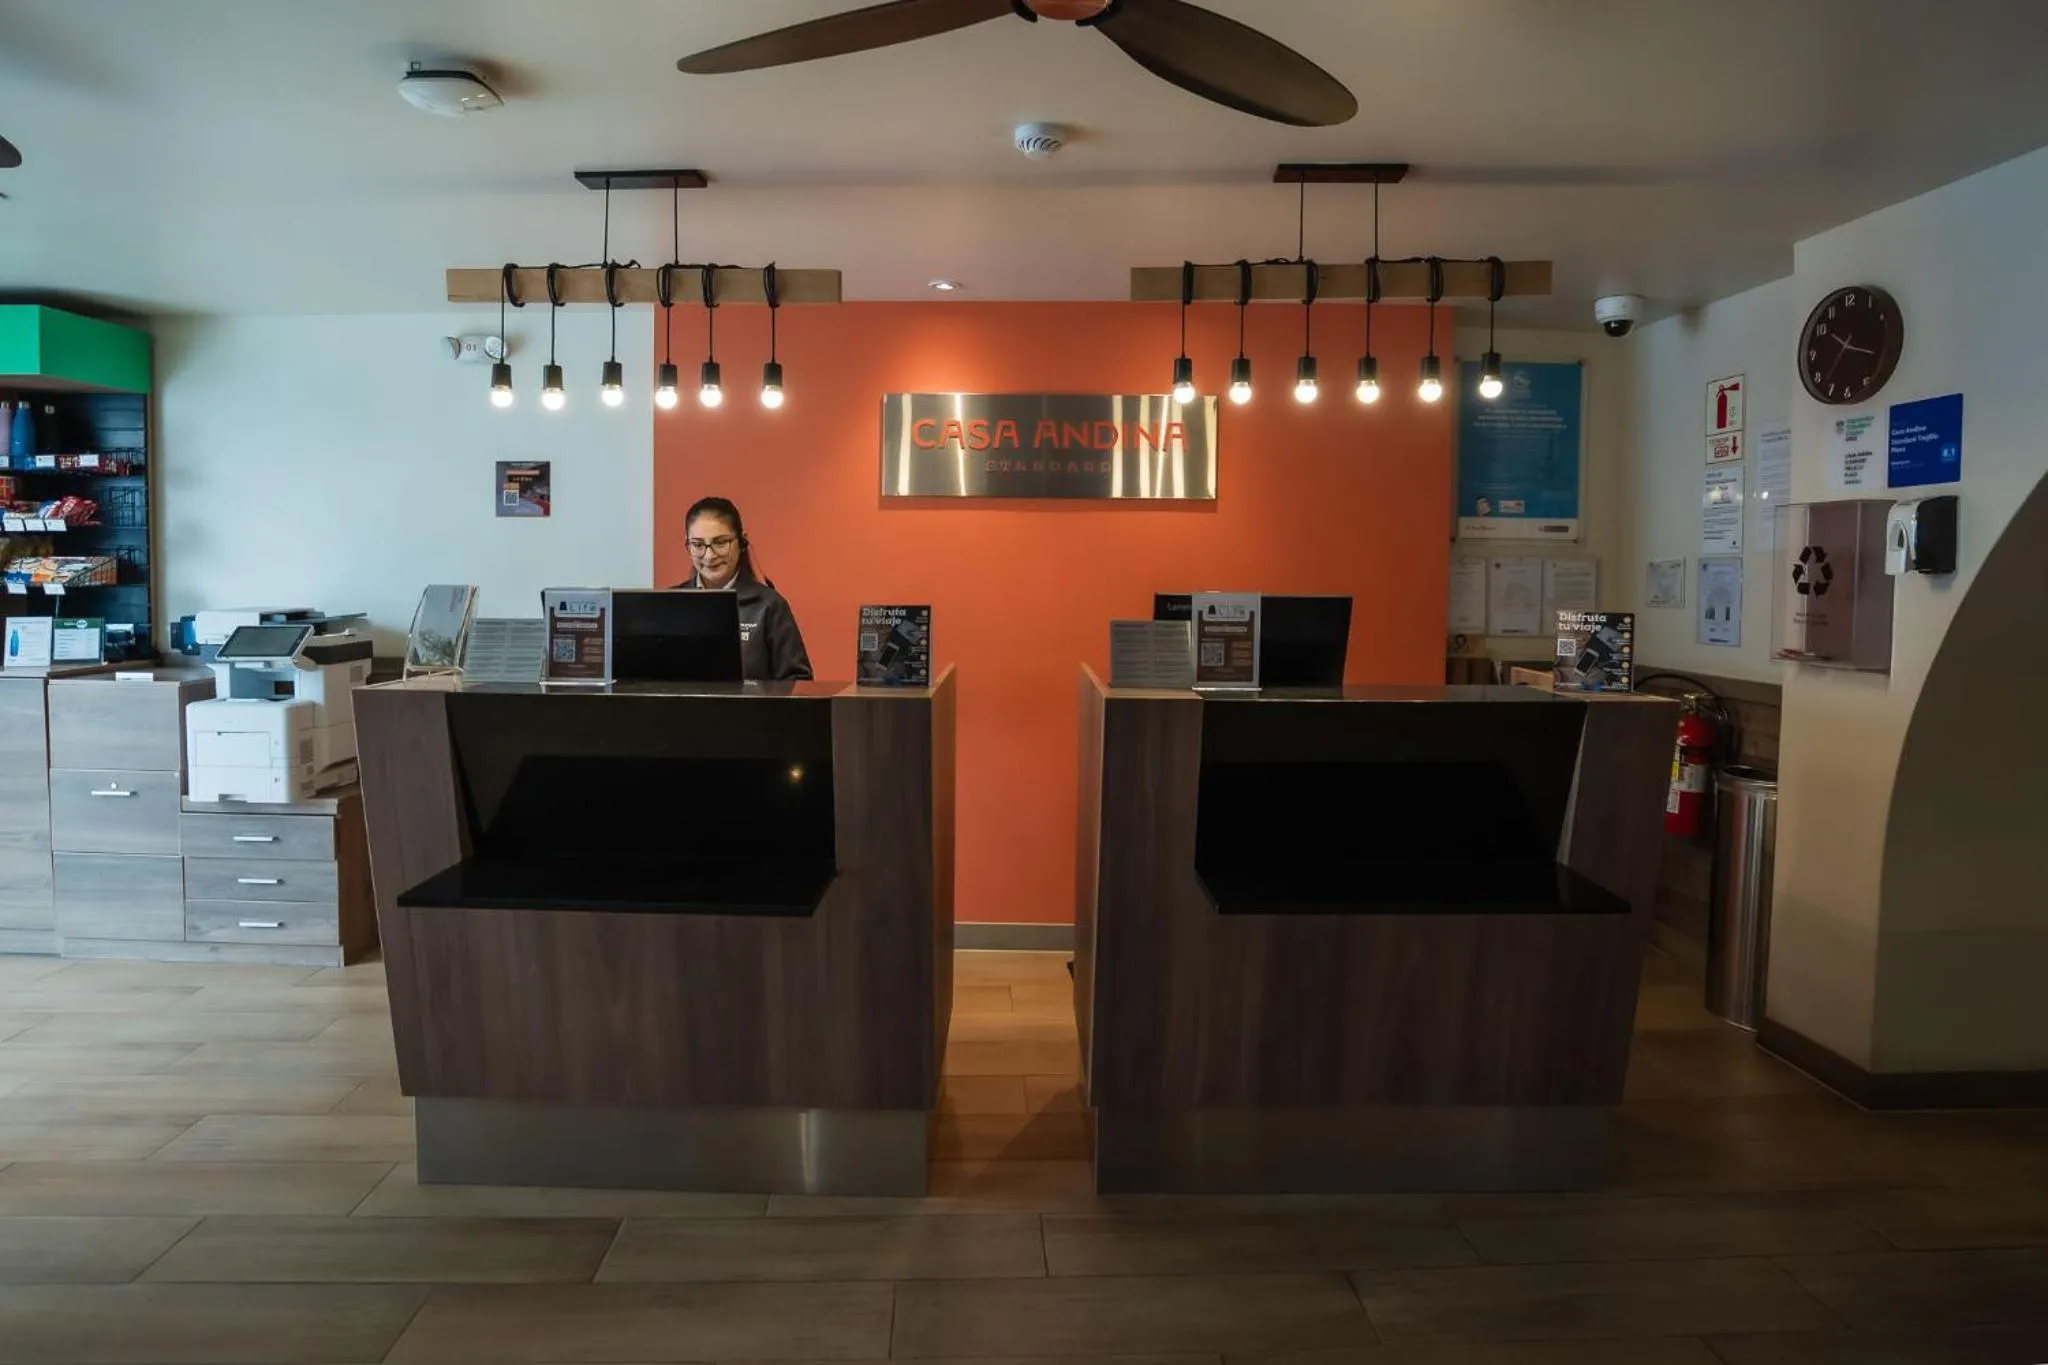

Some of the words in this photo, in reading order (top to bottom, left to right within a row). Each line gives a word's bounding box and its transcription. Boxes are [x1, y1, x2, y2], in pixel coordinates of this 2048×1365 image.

[1845, 293, 1855, 307] 12
[1828, 306, 1835, 320] 11
[1816, 323, 1827, 336] 10
[1809, 350, 1817, 361] 9
[1814, 372, 1821, 383] 8
[1828, 383, 1835, 397] 7
[1843, 386, 1851, 399] 6
[911, 418, 1020, 451] CASA
[1033, 421, 1189, 453] ANDINA
[862, 607, 907, 616] Disfruta
[1559, 611, 1607, 622] Disfruta
[861, 617, 873, 625] tu
[875, 616, 902, 627] viaje
[1558, 622, 1570, 630] tu
[1572, 622, 1602, 633] viaje
